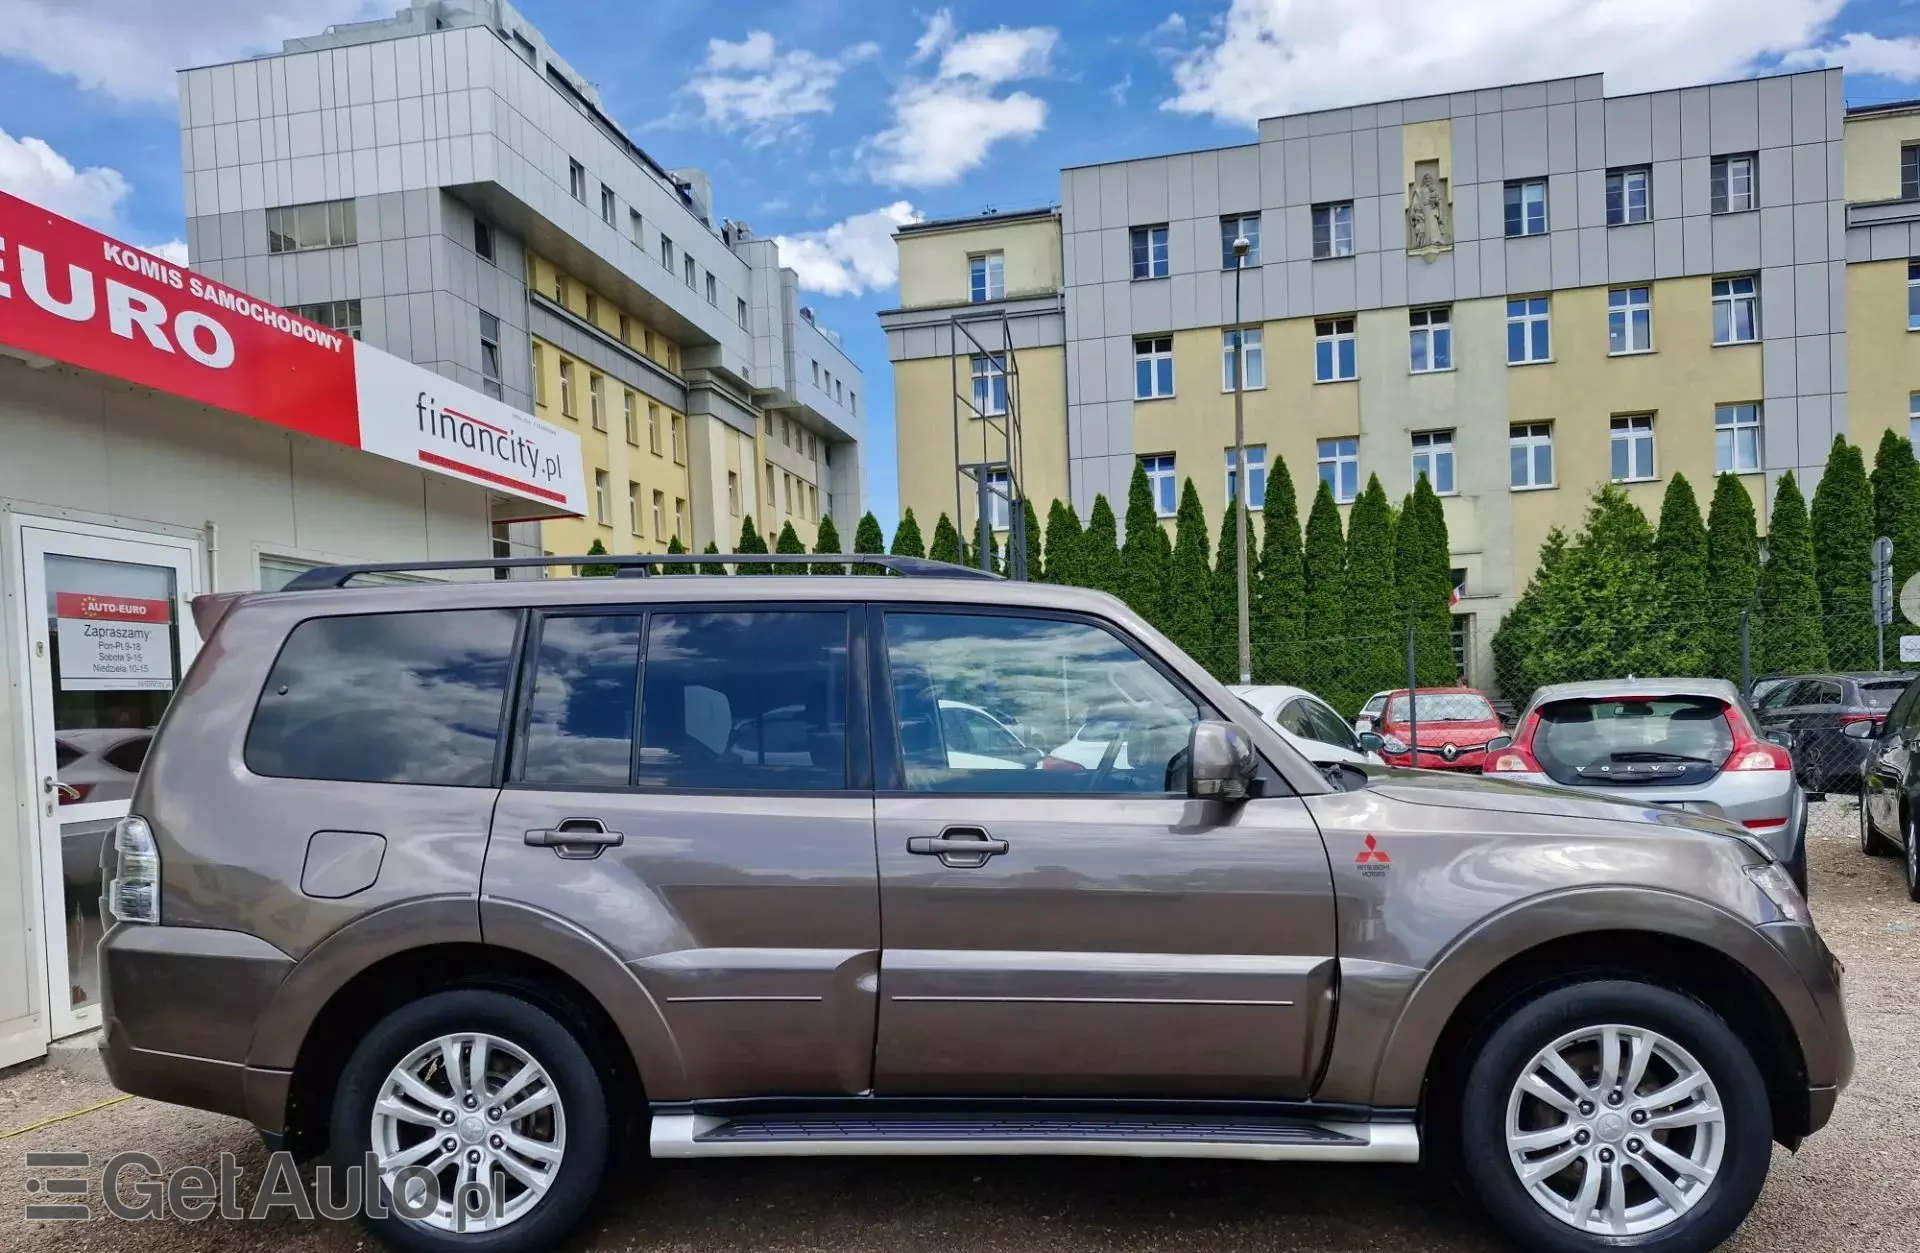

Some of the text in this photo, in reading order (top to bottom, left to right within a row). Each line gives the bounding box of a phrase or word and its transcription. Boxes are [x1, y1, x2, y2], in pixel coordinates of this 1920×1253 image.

[0, 235, 235, 369] URO
[103, 240, 343, 352] KOMIS SAMOCHODOWY
[416, 391, 562, 482] financity.pl
[87, 601, 147, 614] AUTO-EURO
[93, 663, 149, 673] Niedziela 10-15
[98, 652, 125, 662] Sobota
